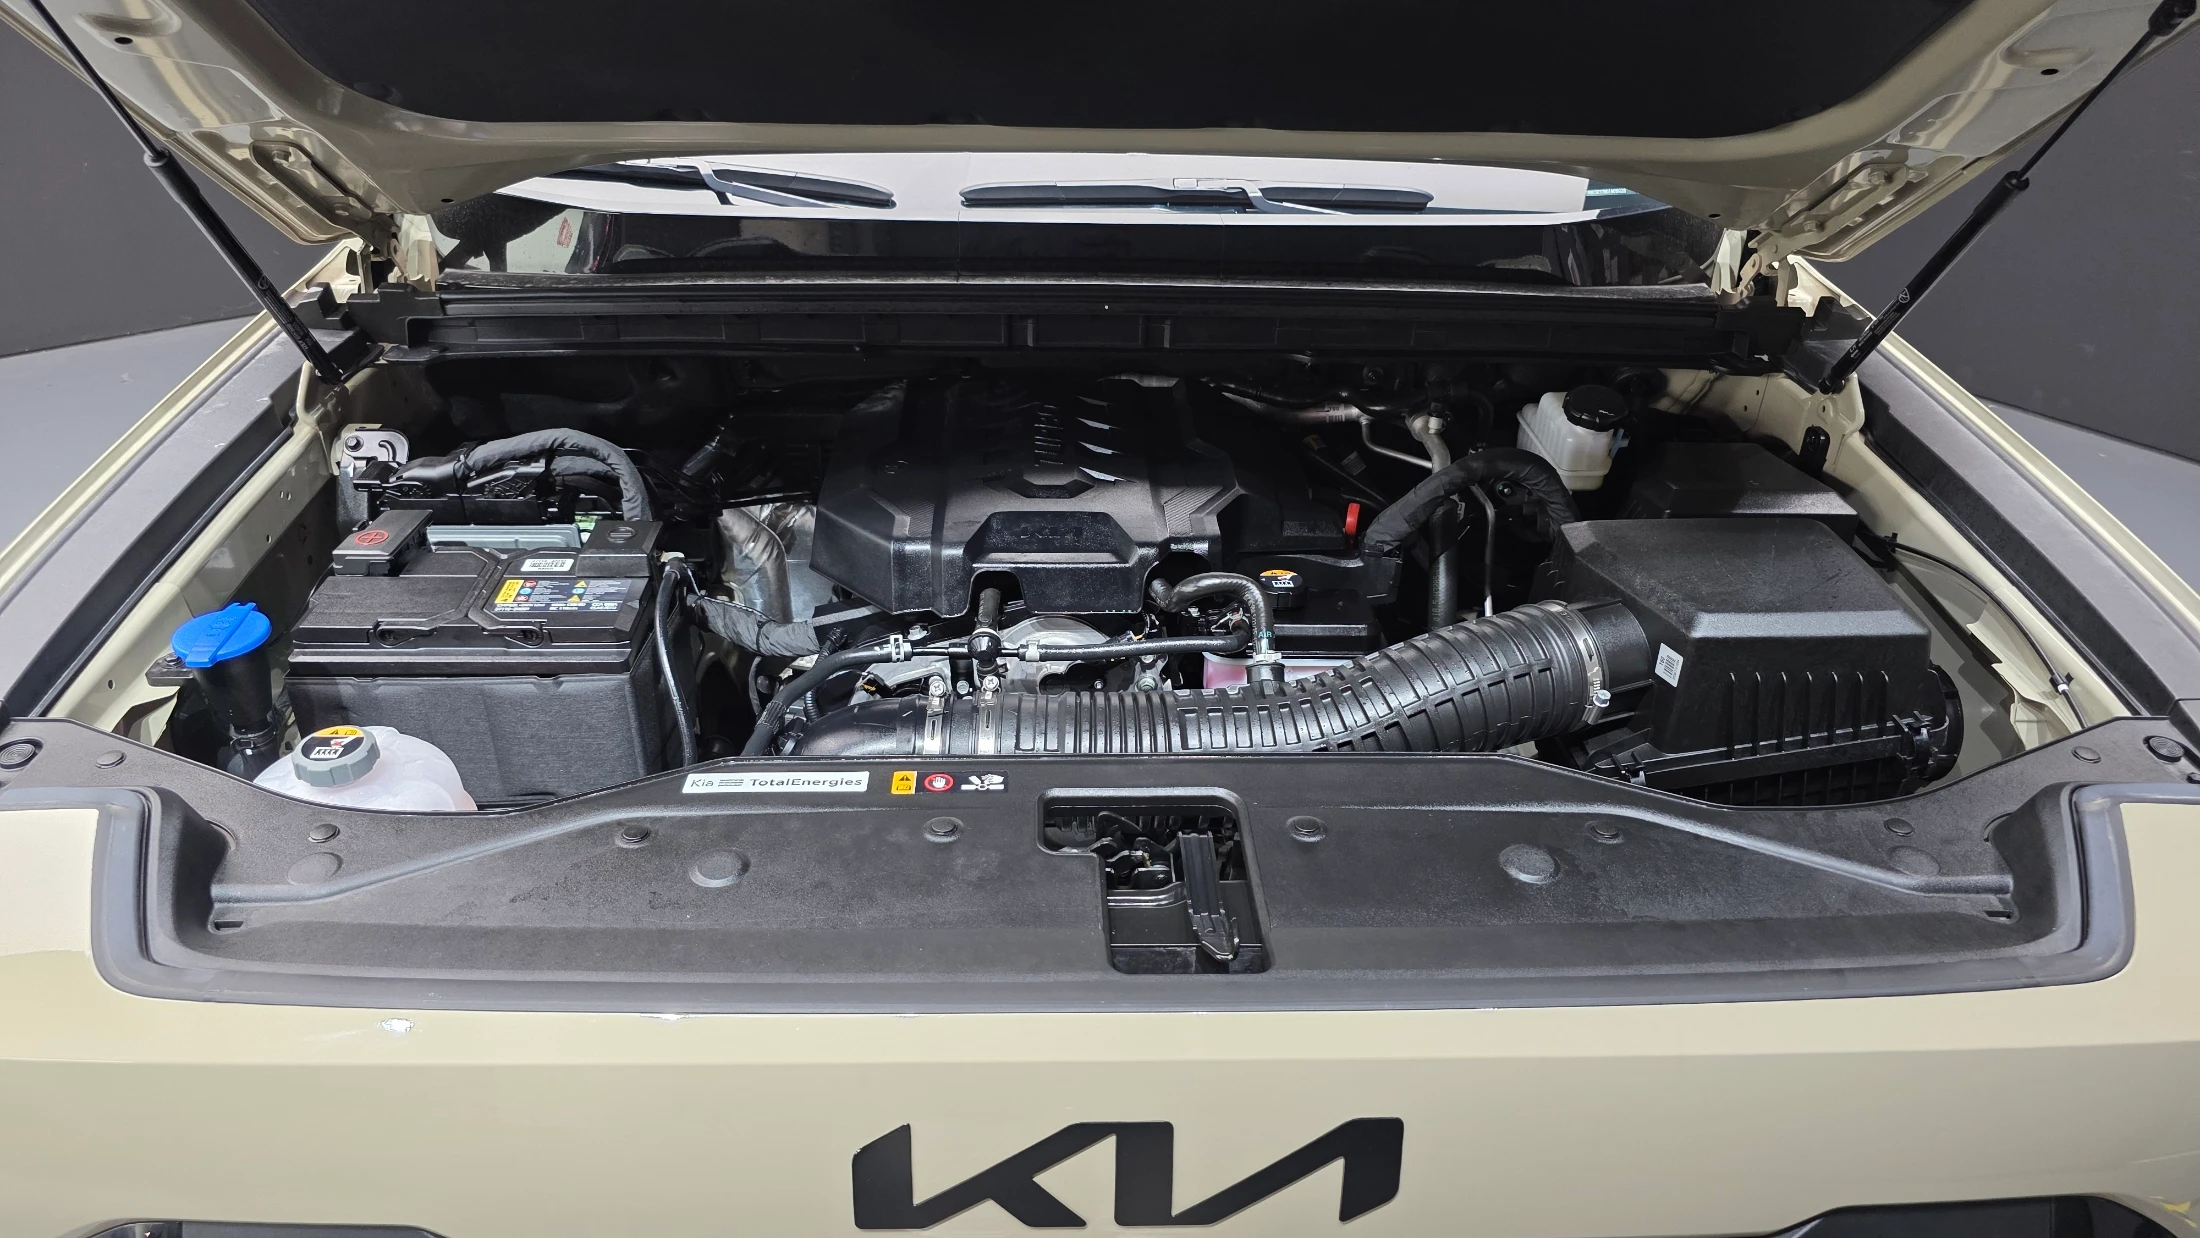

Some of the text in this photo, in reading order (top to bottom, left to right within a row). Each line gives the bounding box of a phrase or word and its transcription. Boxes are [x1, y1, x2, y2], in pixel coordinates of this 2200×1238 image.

[1257, 630, 1273, 638] AIR
[690, 777, 863, 788] Kia TotalEnergies
